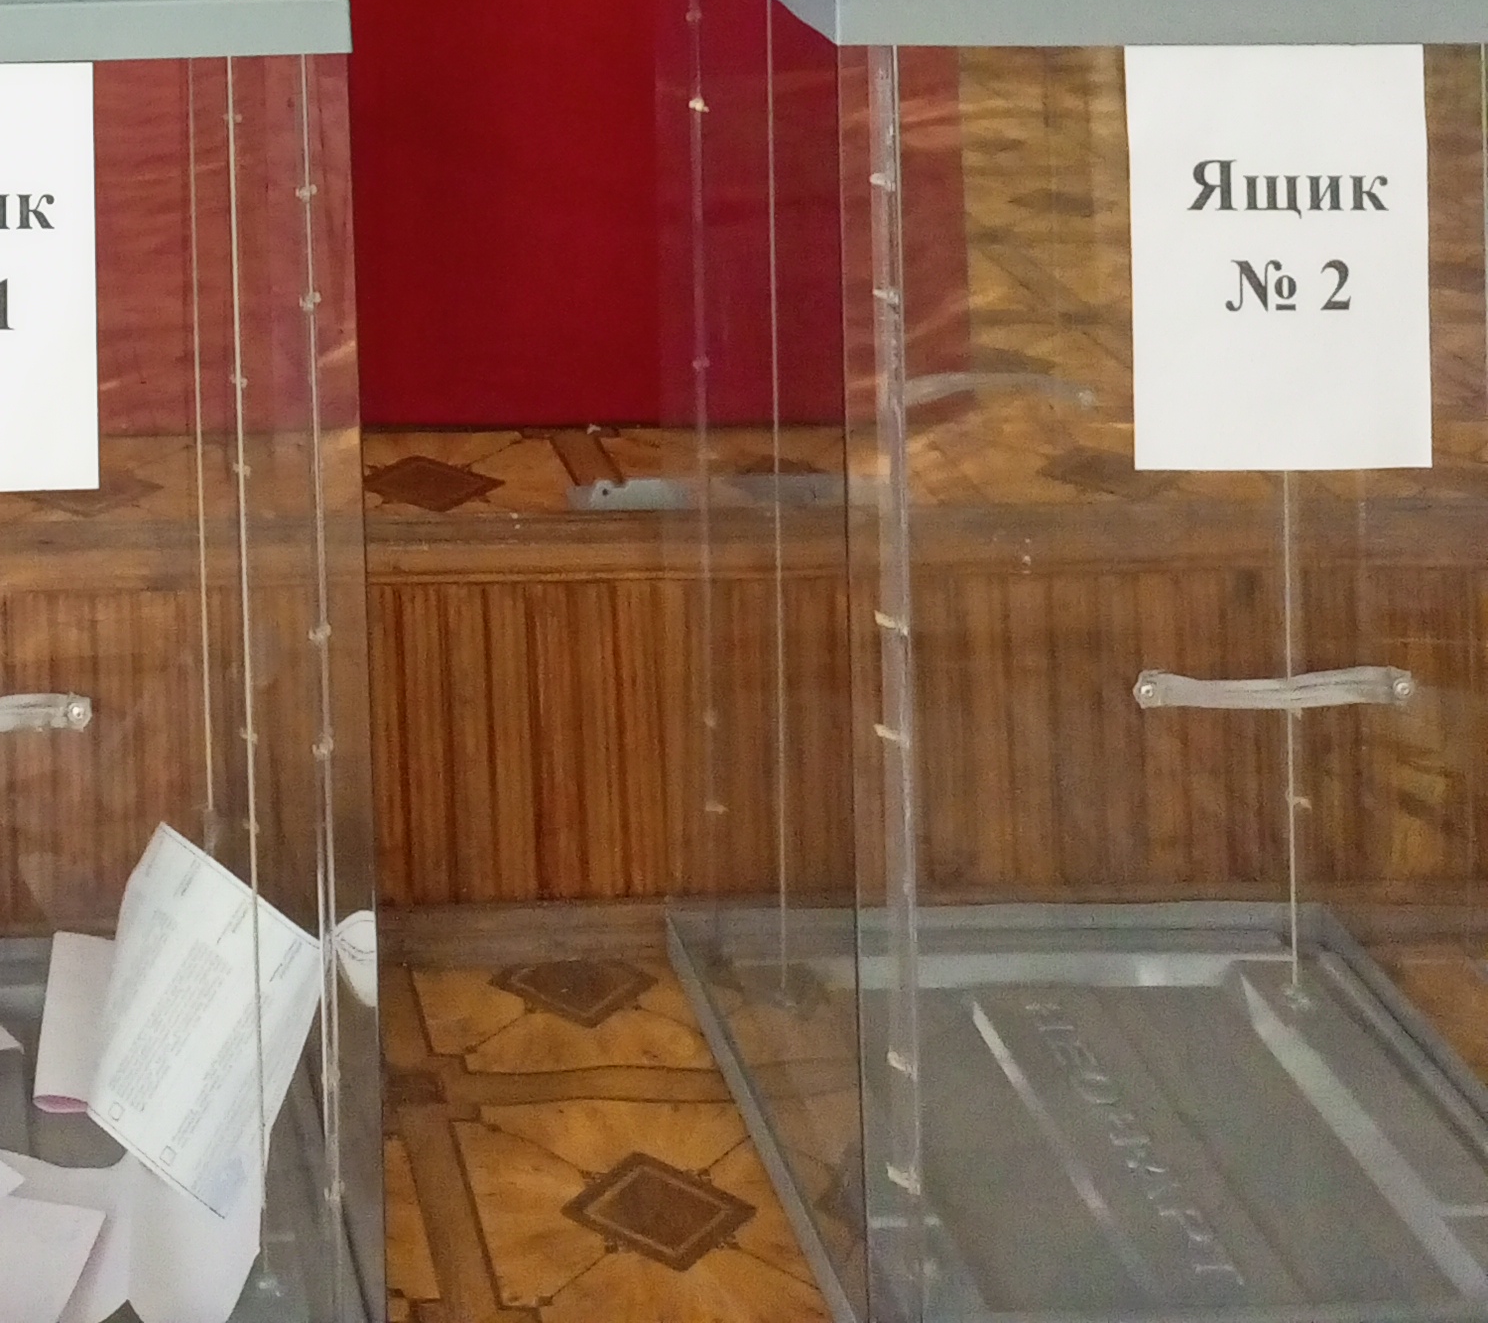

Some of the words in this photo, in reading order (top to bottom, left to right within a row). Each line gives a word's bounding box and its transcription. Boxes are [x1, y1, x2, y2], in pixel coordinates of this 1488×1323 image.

[1187, 158, 1390, 220] Ящик
[1224, 259, 1298, 313] №
[1320, 259, 1353, 312] 2
